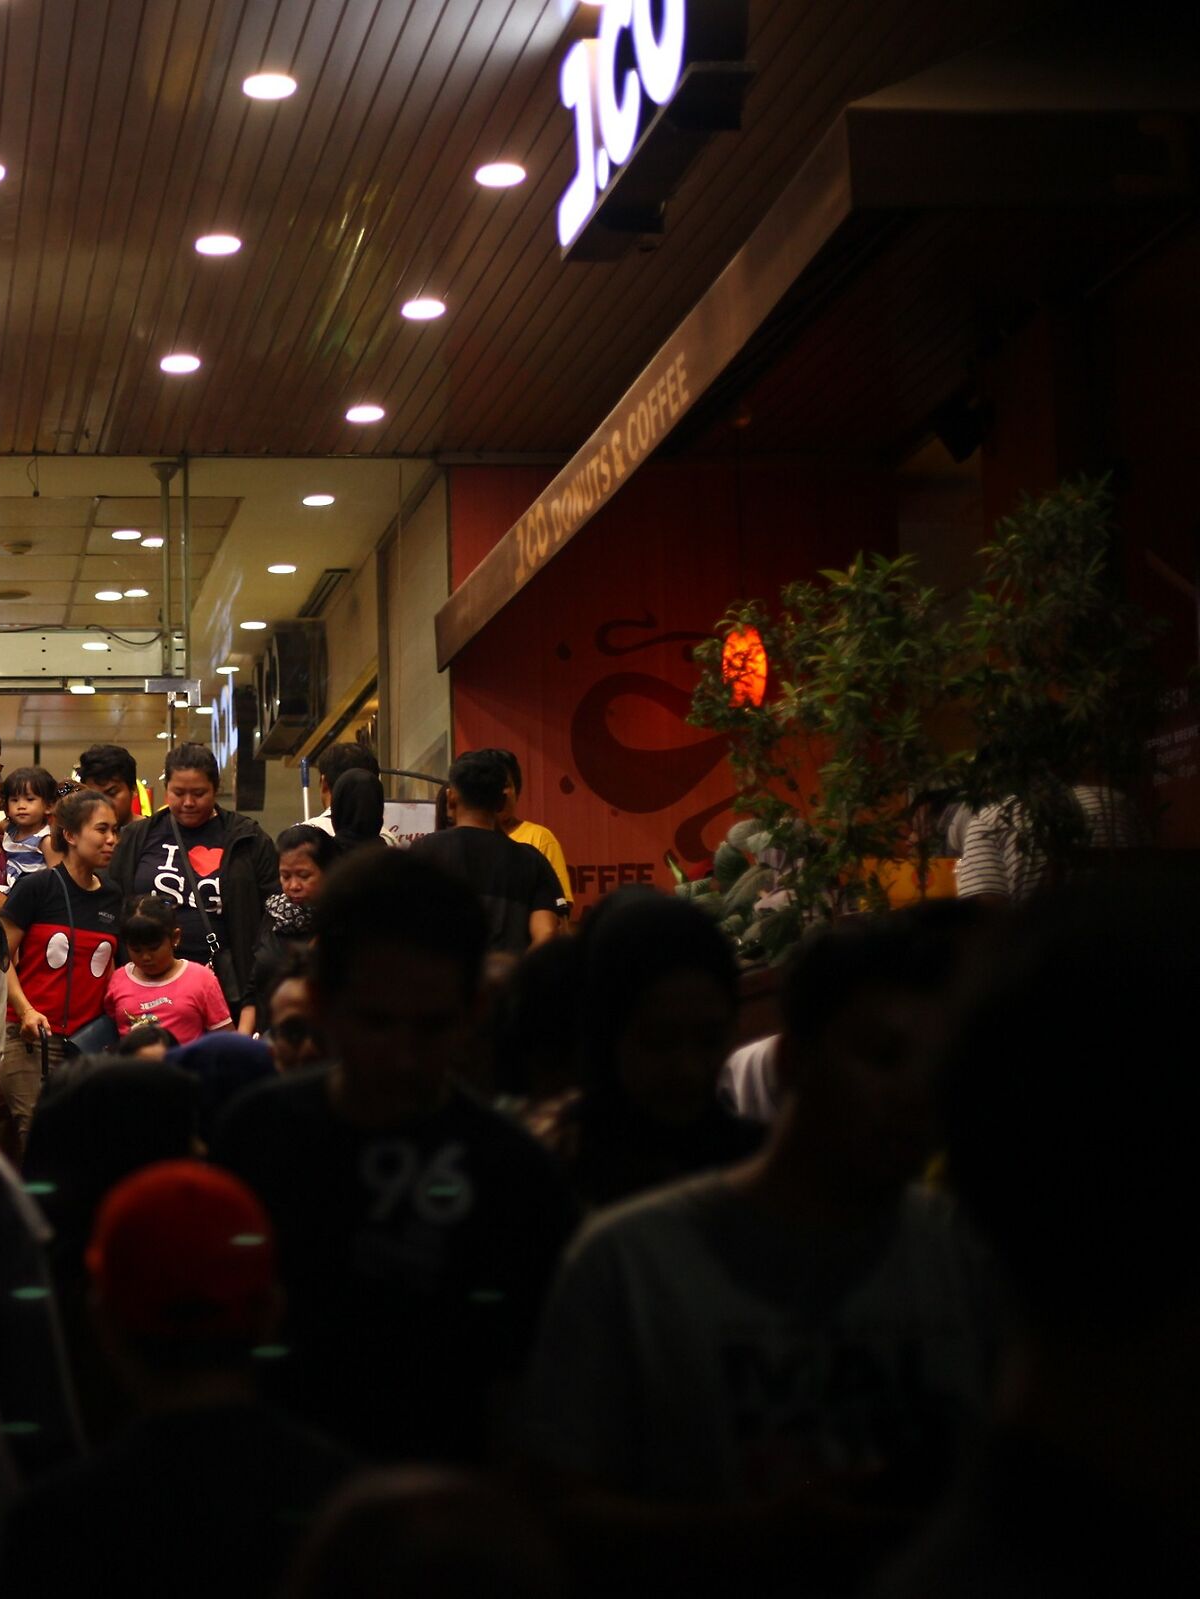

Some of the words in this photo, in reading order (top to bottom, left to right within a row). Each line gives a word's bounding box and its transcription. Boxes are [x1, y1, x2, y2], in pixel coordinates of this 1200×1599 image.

[550, 444, 611, 542] DONUTS
[626, 351, 689, 461] COFFEE
[157, 843, 180, 872] I
[151, 872, 224, 915] SG
[358, 1137, 479, 1225] 96
